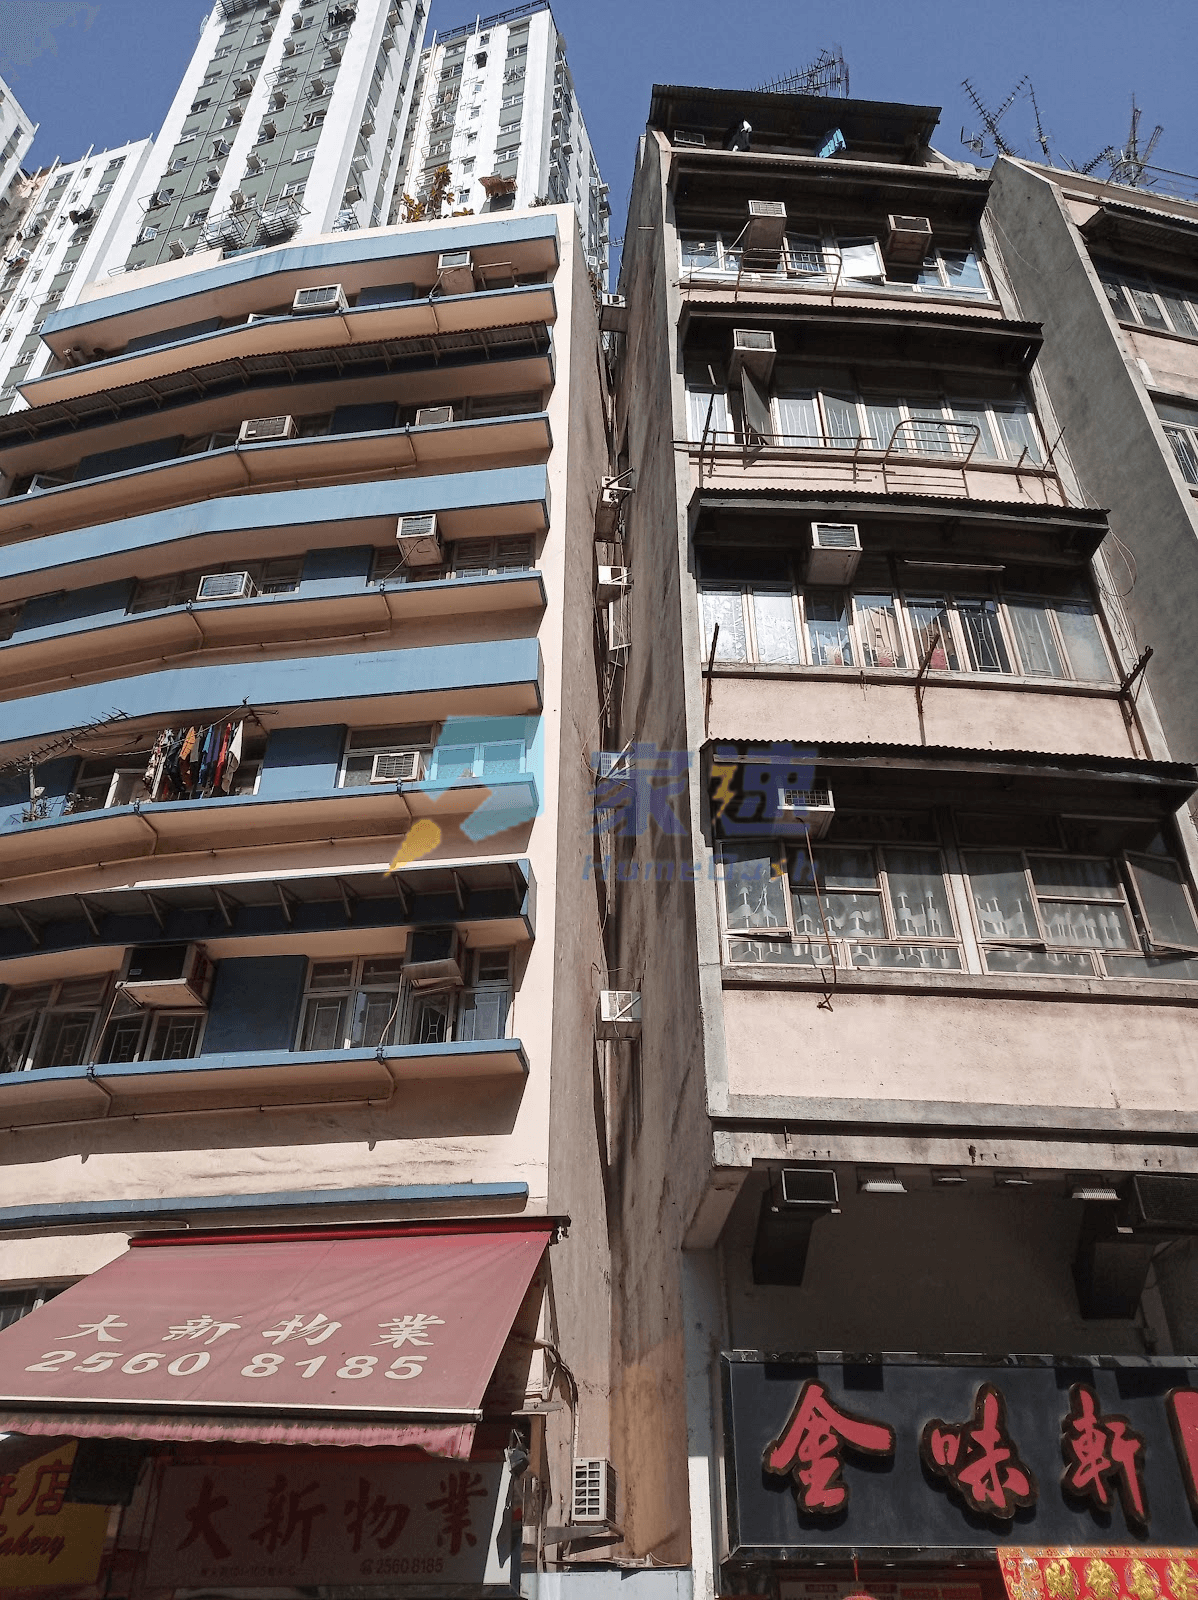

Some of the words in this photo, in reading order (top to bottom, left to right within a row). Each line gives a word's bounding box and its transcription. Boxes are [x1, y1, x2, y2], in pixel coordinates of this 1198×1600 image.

[54, 1312, 446, 1348] 大新物業
[24, 1349, 211, 1377] 2560
[240, 1351, 429, 1380] 8185
[0, 1458, 74, 1516] 店
[176, 1470, 489, 1561] 大新物業
